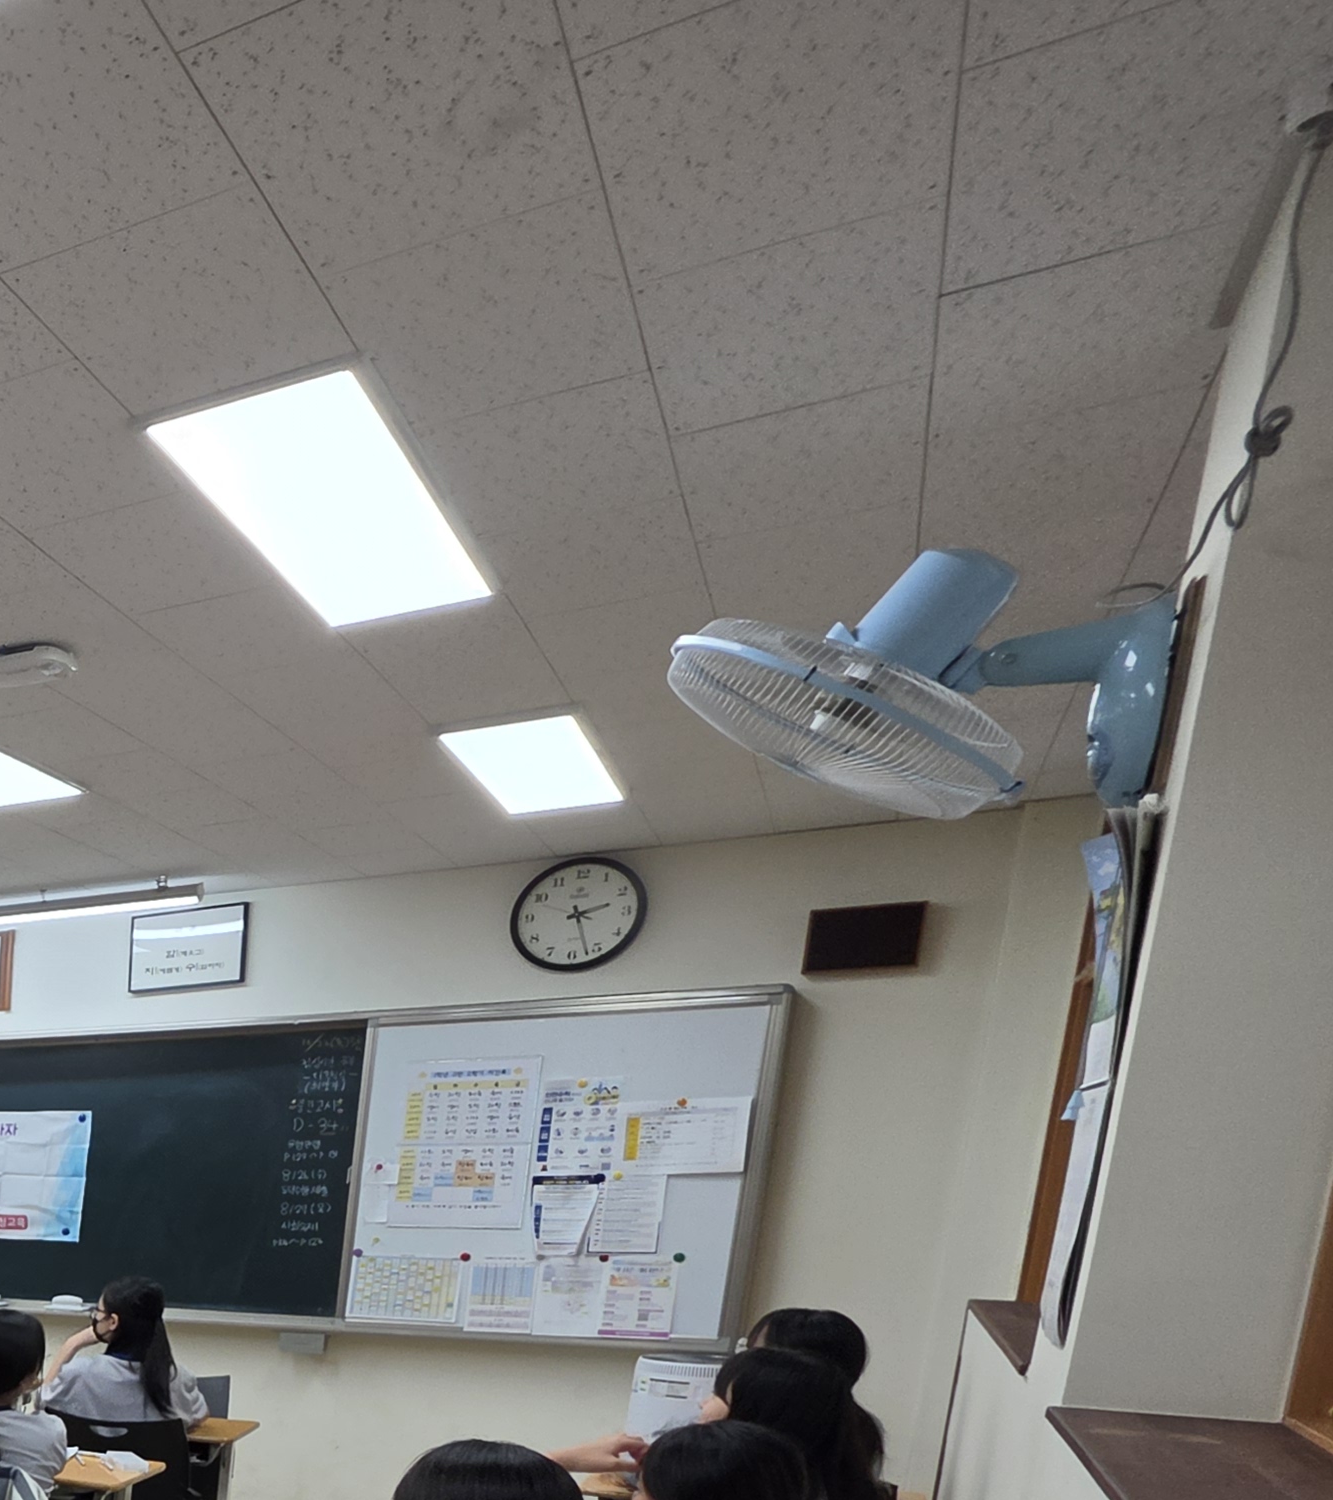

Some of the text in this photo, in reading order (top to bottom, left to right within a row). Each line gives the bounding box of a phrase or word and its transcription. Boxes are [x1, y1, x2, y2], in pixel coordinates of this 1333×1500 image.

[576, 868, 591, 880] 12
[603, 872, 610, 883] 1
[552, 877, 565, 888] 11
[616, 885, 628, 897] 2
[534, 892, 549, 903] 10
[621, 905, 632, 917] 3
[524, 913, 535, 924] 9
[611, 927, 622, 937] 4
[529, 933, 540, 944] 8
[545, 946, 555, 957] 7
[591, 942, 603, 954] 5
[567, 950, 577, 961] 6
